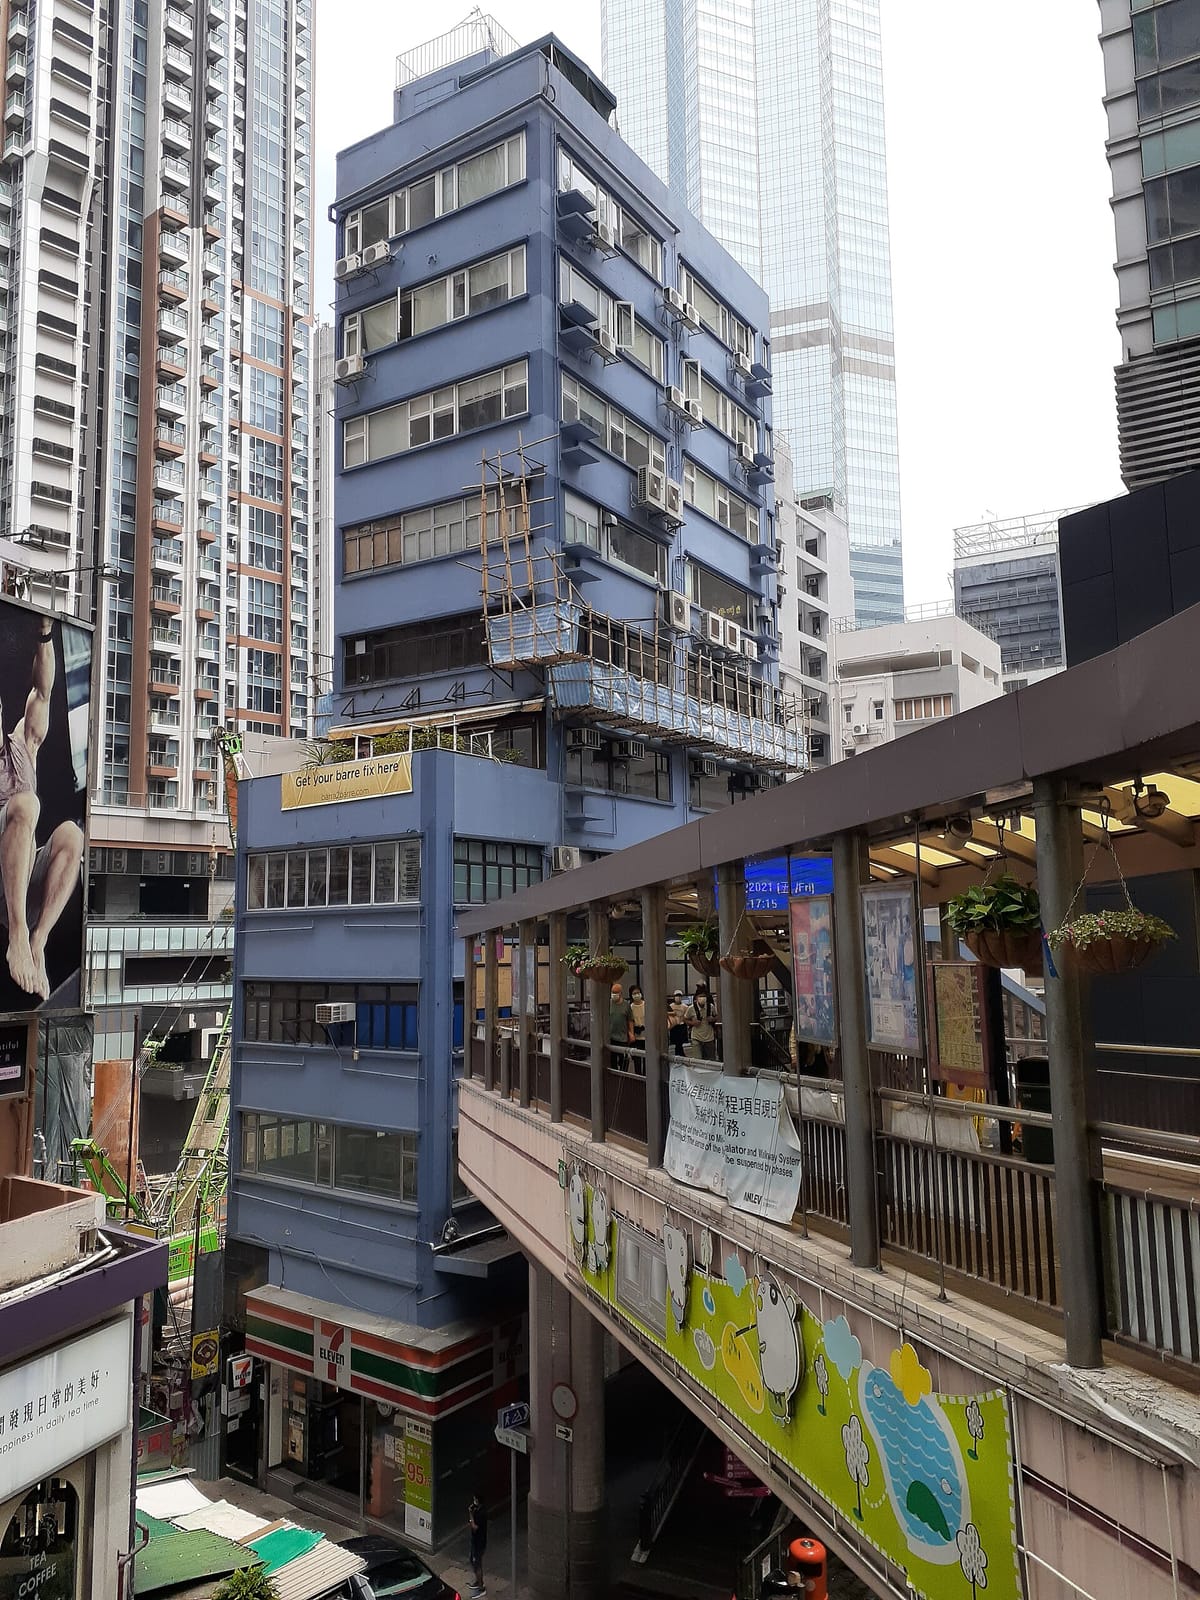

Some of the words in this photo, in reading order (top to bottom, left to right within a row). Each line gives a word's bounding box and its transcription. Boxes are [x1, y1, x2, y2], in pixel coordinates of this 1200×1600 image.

[295, 776, 311, 787] Get
[313, 772, 333, 787] your
[336, 769, 360, 782] barre
[363, 763, 375, 777] fix
[377, 761, 399, 774] here
[705, 1142, 711, 1151] of
[712, 1144, 722, 1154] the
[764, 1163, 772, 1175] by
[771, 1165, 793, 1179] phases
[36, 1425, 44, 1436] in
[46, 1414, 66, 1430] daily
[67, 1407, 81, 1419] tea
[83, 1397, 100, 1411] time
[29, 1550, 47, 1571] TEA
[18, 1562, 57, 1597] COFFEE
